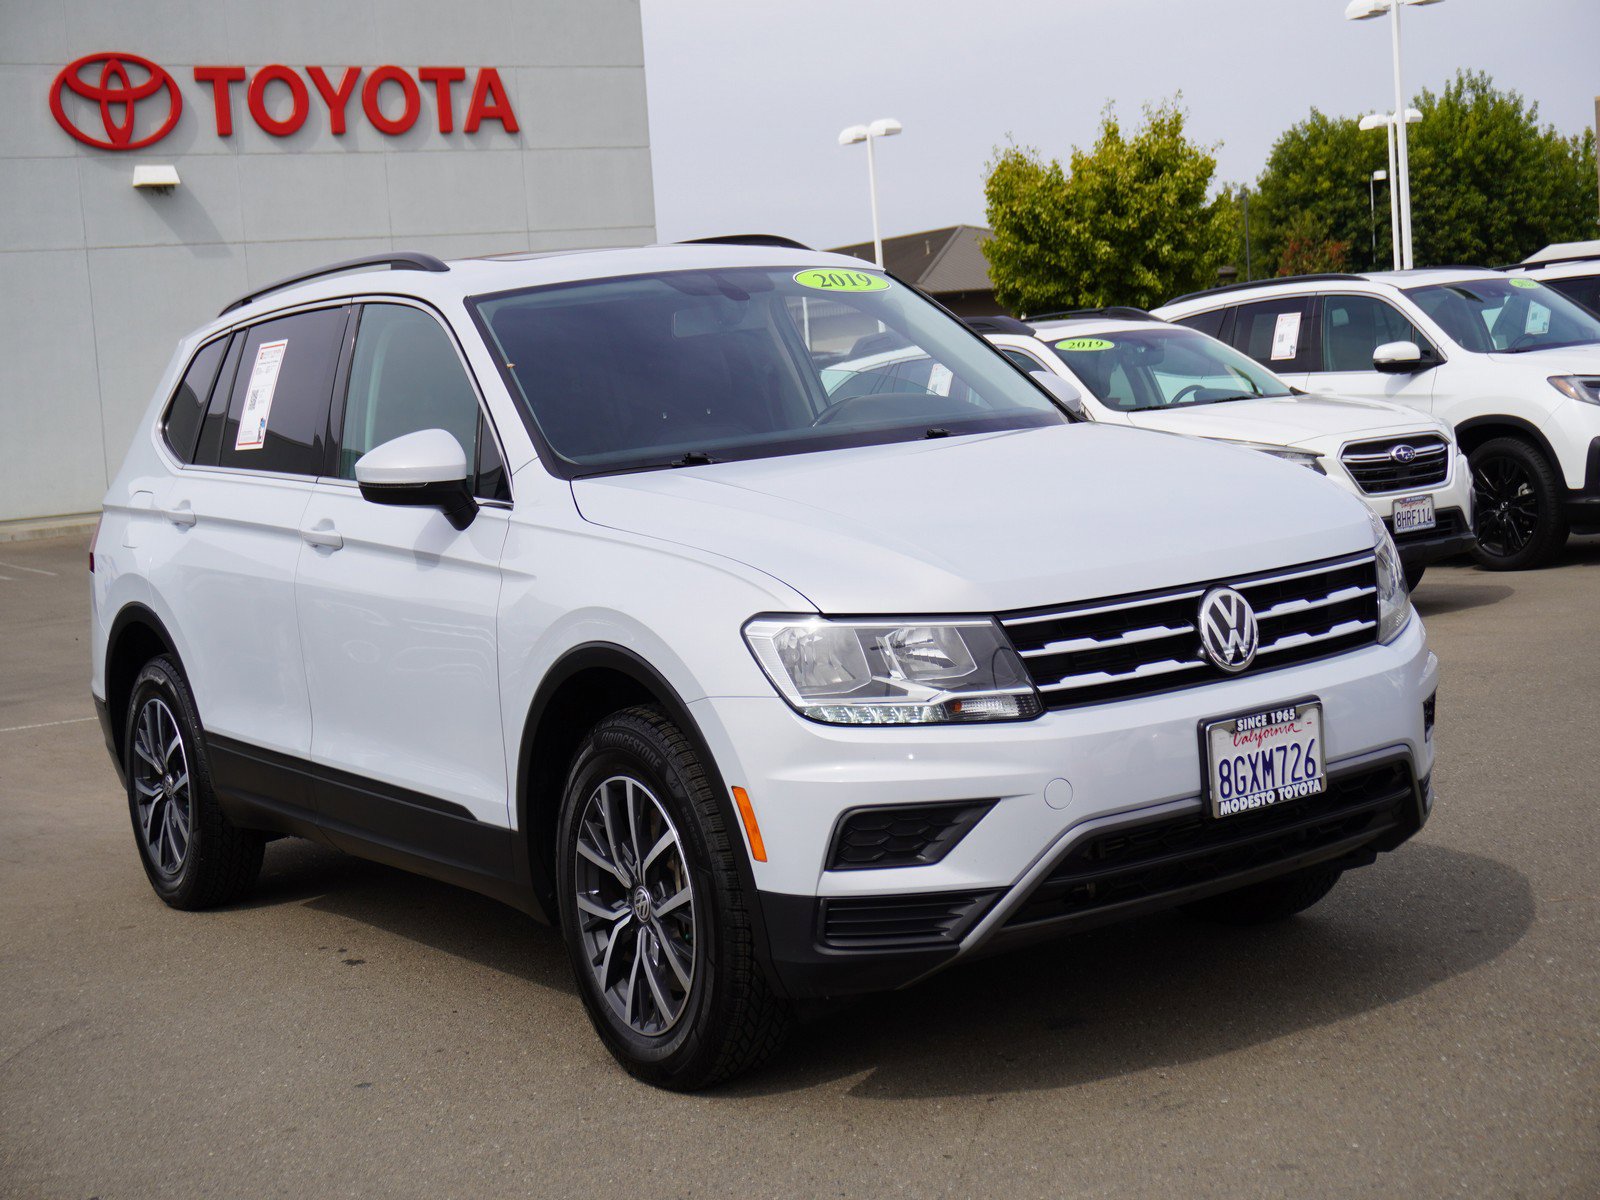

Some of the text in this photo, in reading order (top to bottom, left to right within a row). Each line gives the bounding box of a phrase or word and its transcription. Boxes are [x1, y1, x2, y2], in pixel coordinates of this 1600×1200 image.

[194, 64, 520, 137] TOYOTA
[813, 273, 872, 288] 2019
[1069, 341, 1103, 349] 2019
[1396, 508, 1432, 527] 8HRF114
[1202, 589, 1257, 670] VW
[1236, 708, 1296, 732] SINCE 1965
[1233, 721, 1302, 748] California
[1218, 738, 1317, 800] 8GXM726
[1220, 779, 1322, 816] MODESTO TOYOTA
